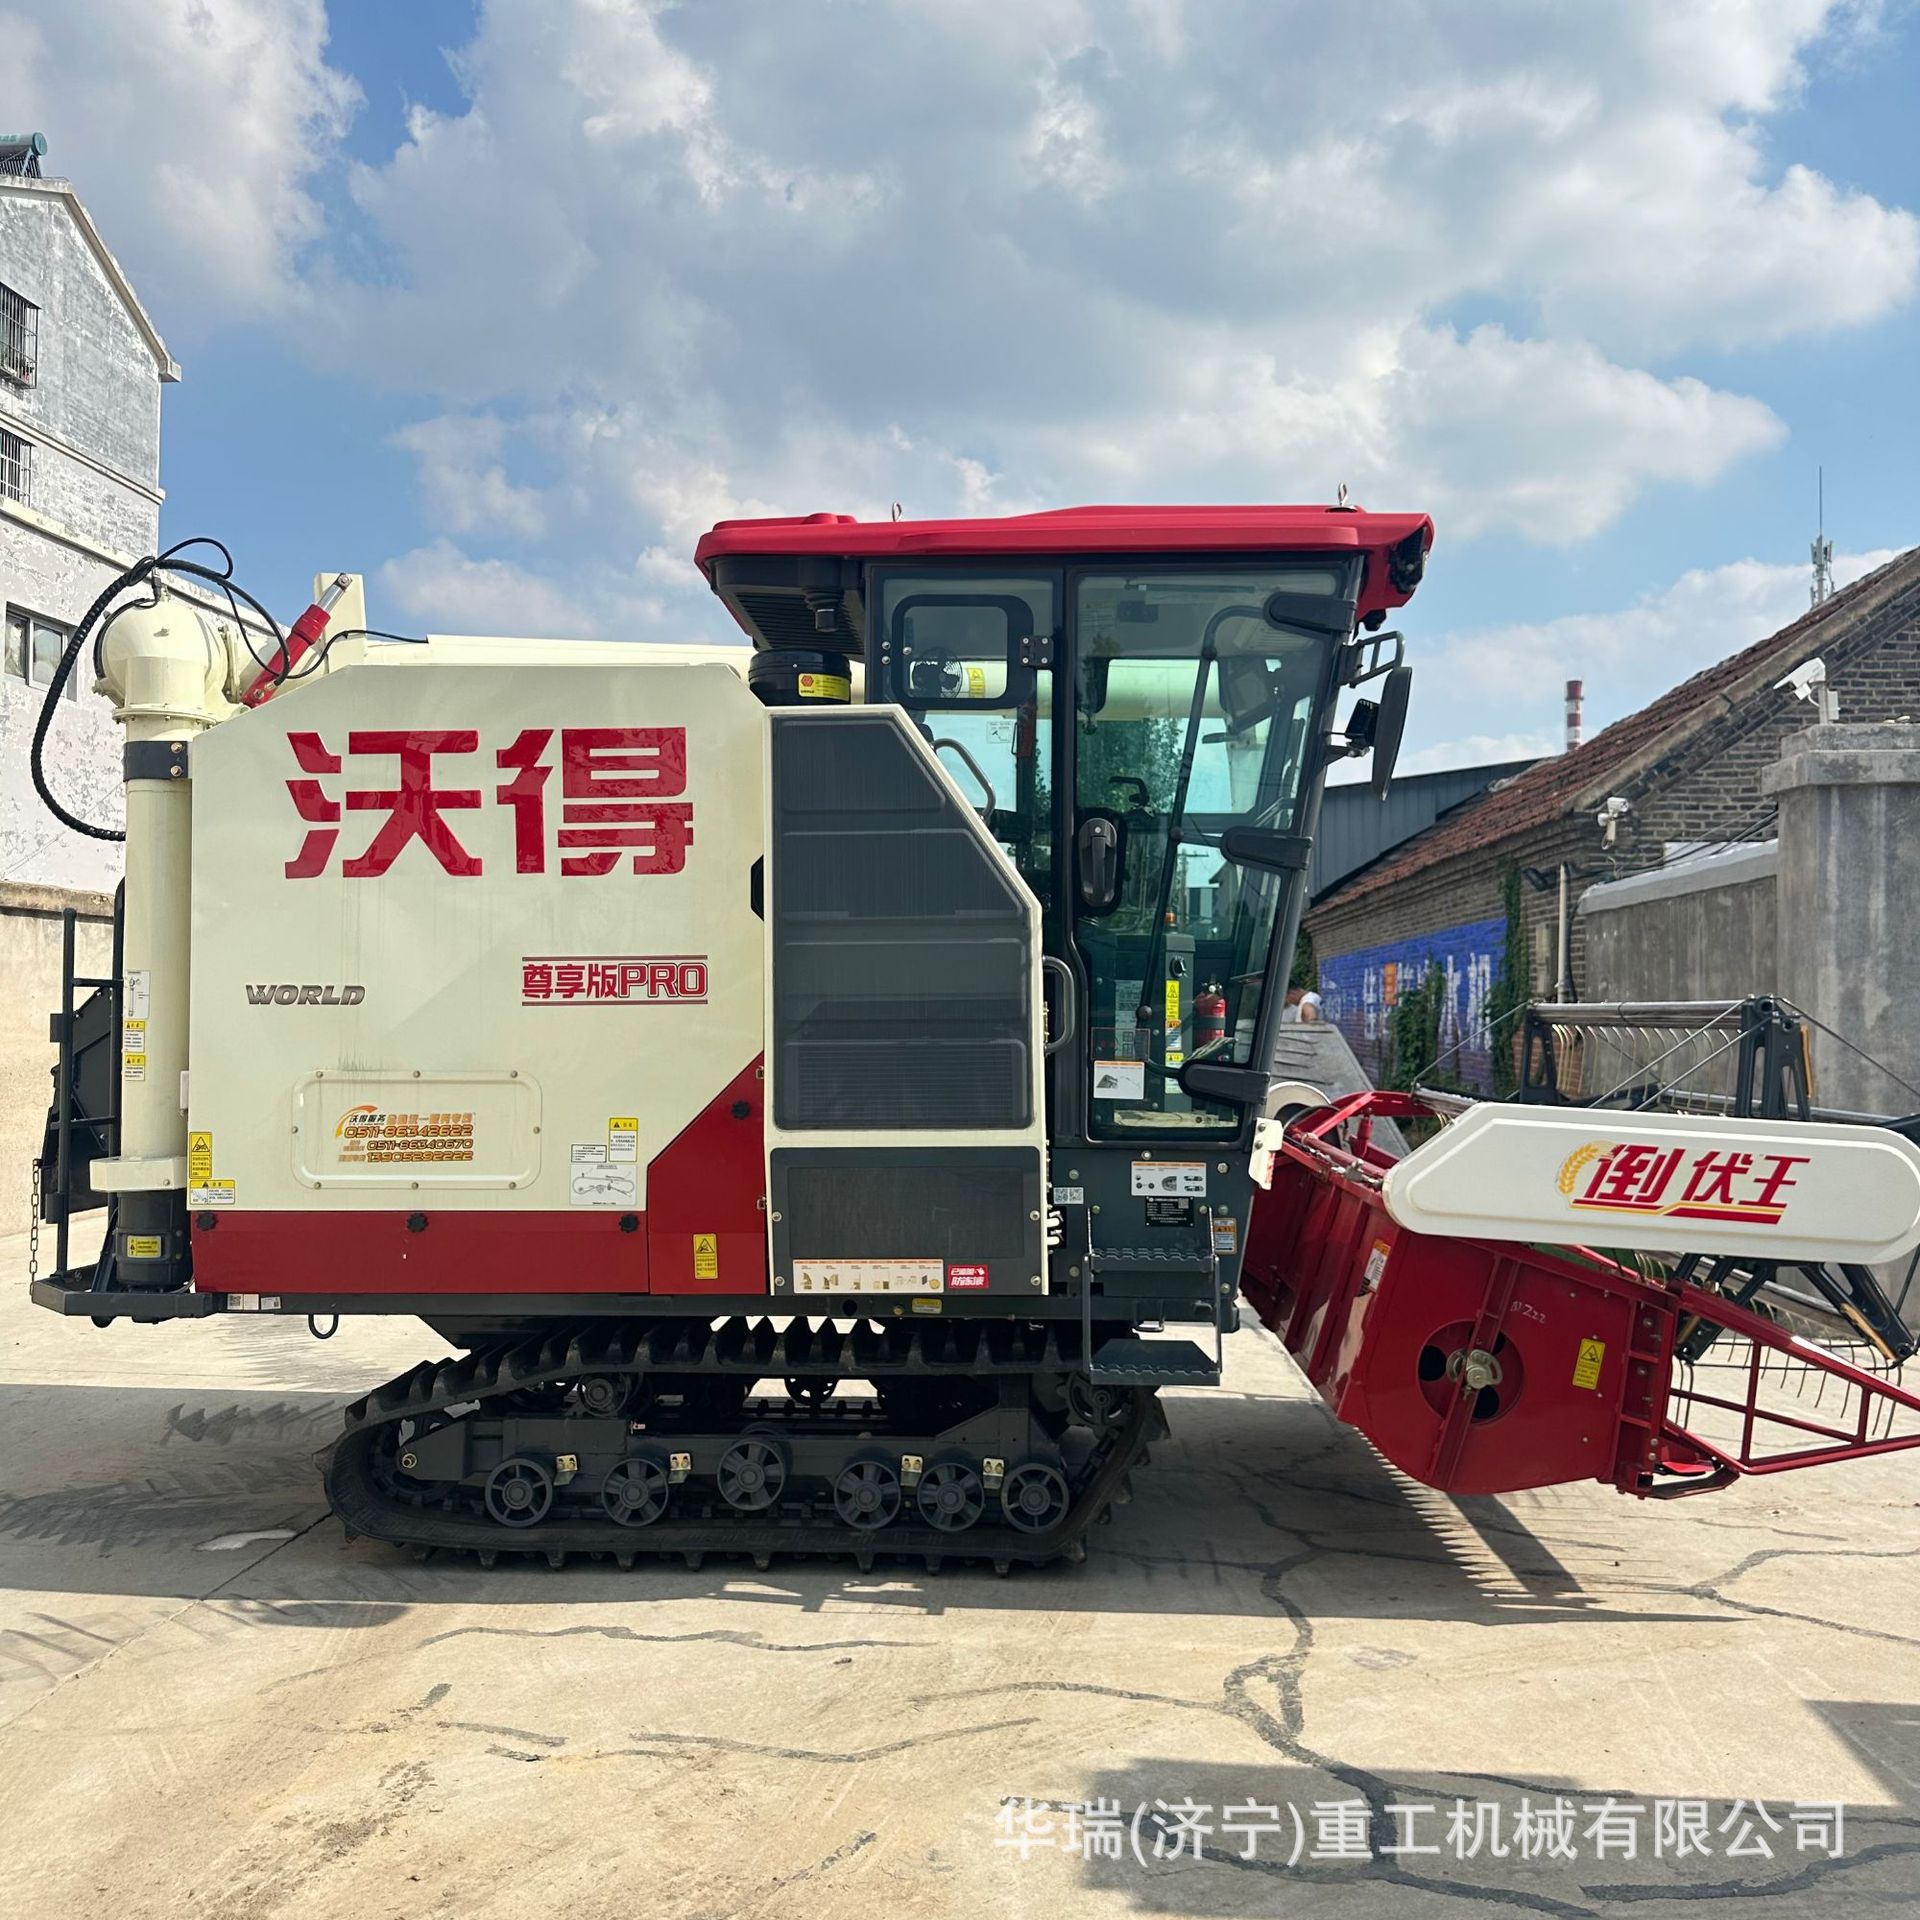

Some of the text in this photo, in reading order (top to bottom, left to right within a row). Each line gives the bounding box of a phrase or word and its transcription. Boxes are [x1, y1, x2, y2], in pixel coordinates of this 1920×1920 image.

[285, 727, 694, 879] 沃得
[245, 984, 366, 1006] WORLD
[522, 963, 708, 999] 尊享版PRO
[344, 1125, 473, 1138] 0511-86342622
[366, 1139, 473, 1151] 0511-86340670
[1583, 1143, 1812, 1209] 倒伏王
